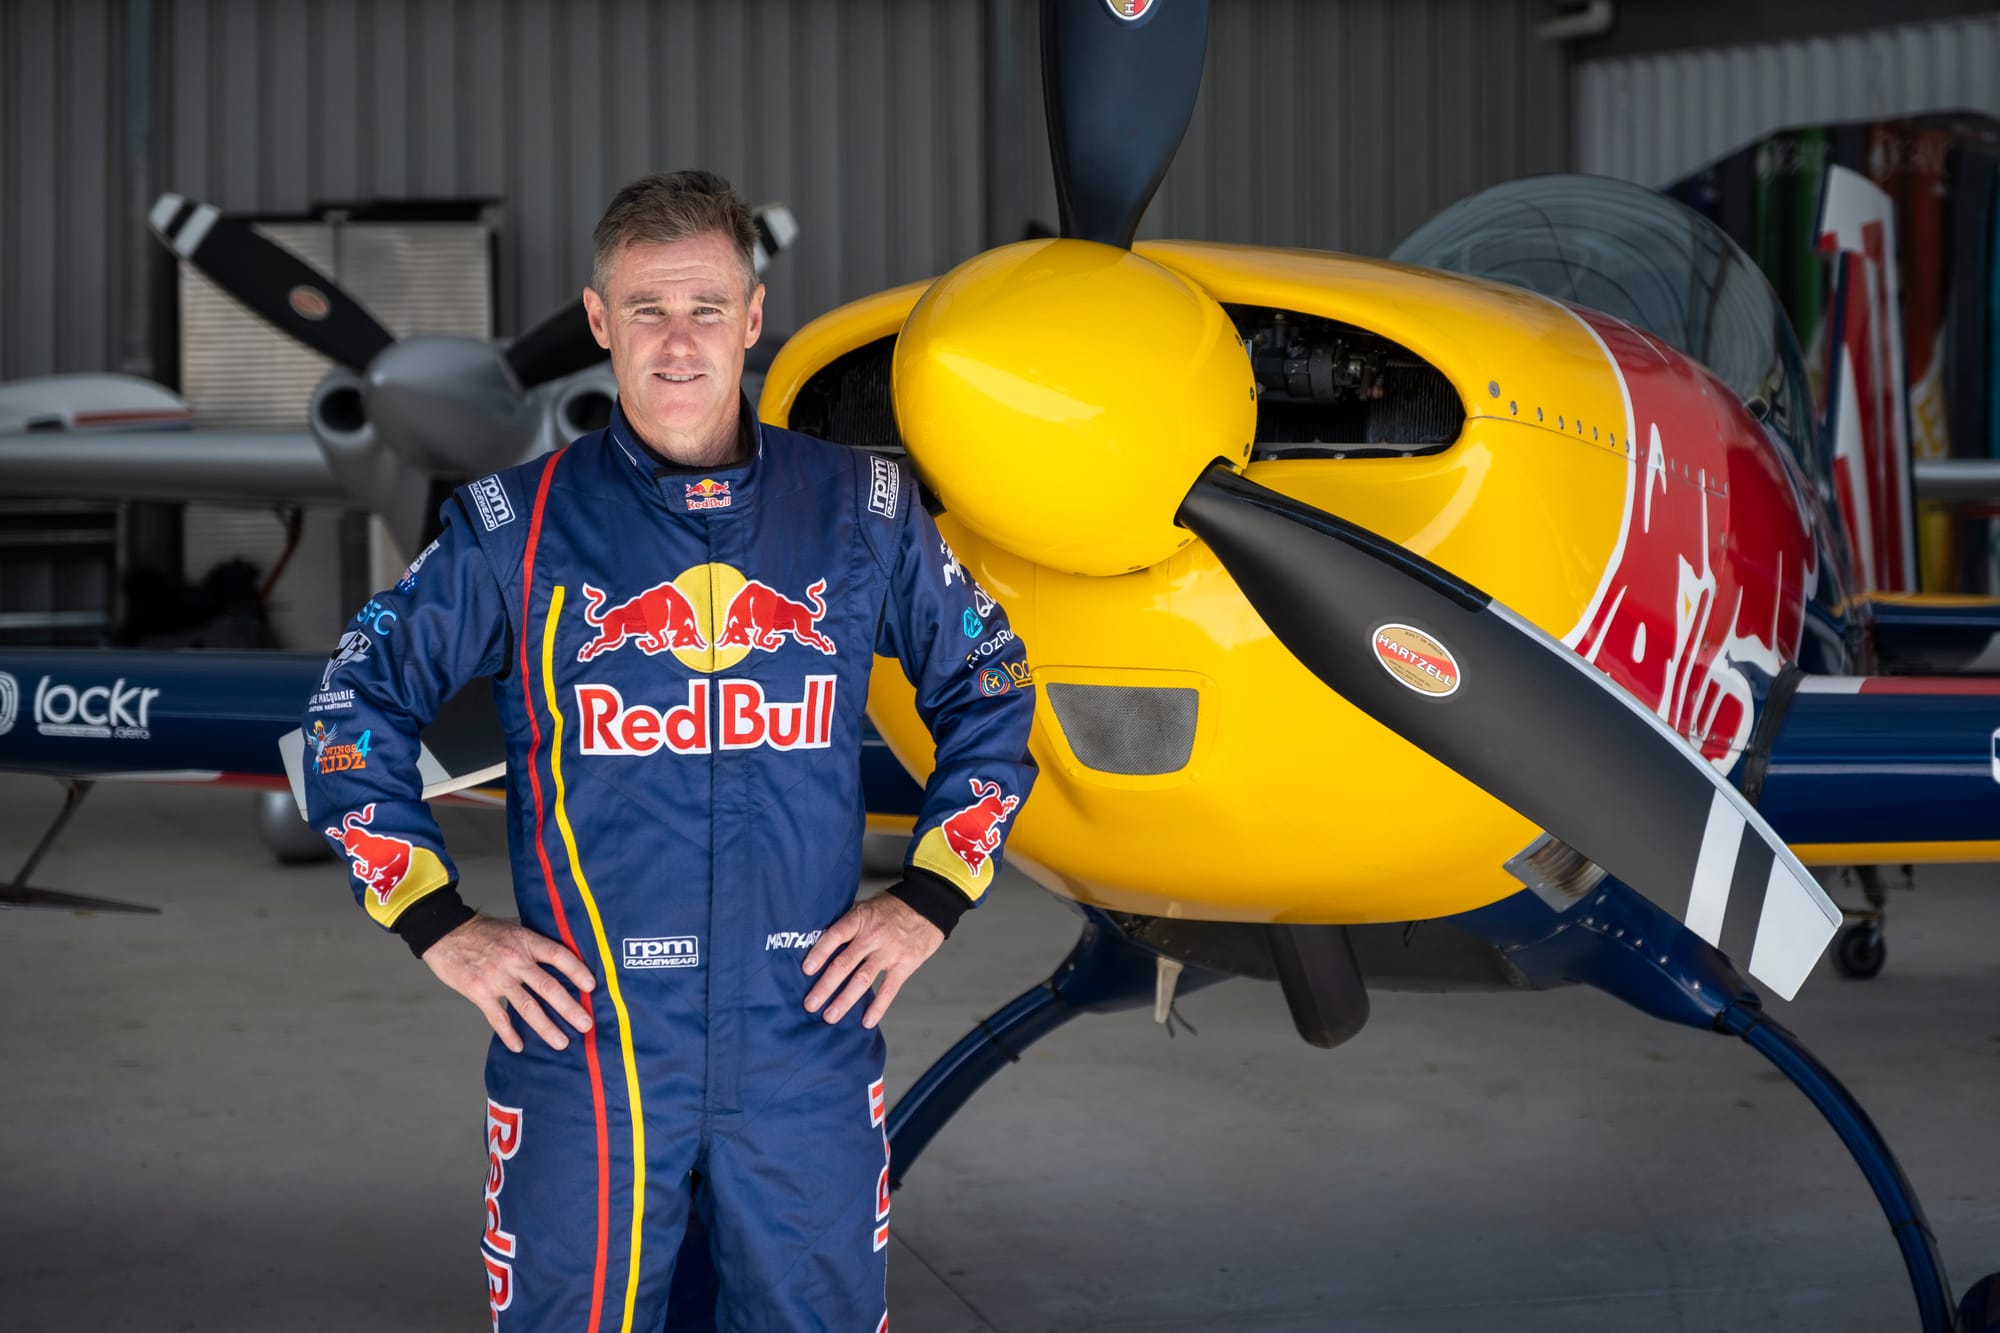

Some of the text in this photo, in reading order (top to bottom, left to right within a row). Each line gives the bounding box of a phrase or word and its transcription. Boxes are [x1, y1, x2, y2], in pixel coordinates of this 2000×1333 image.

[481, 477, 510, 522] rpm
[686, 496, 731, 510] Red Bull
[873, 460, 887, 508] rpm
[1377, 634, 1452, 687] HARTZELL
[34, 675, 160, 728] lockr
[574, 675, 837, 756] Red Bull
[320, 752, 366, 774] KIDZ
[626, 957, 696, 966] RACEWEAR
[629, 939, 693, 957] rpm
